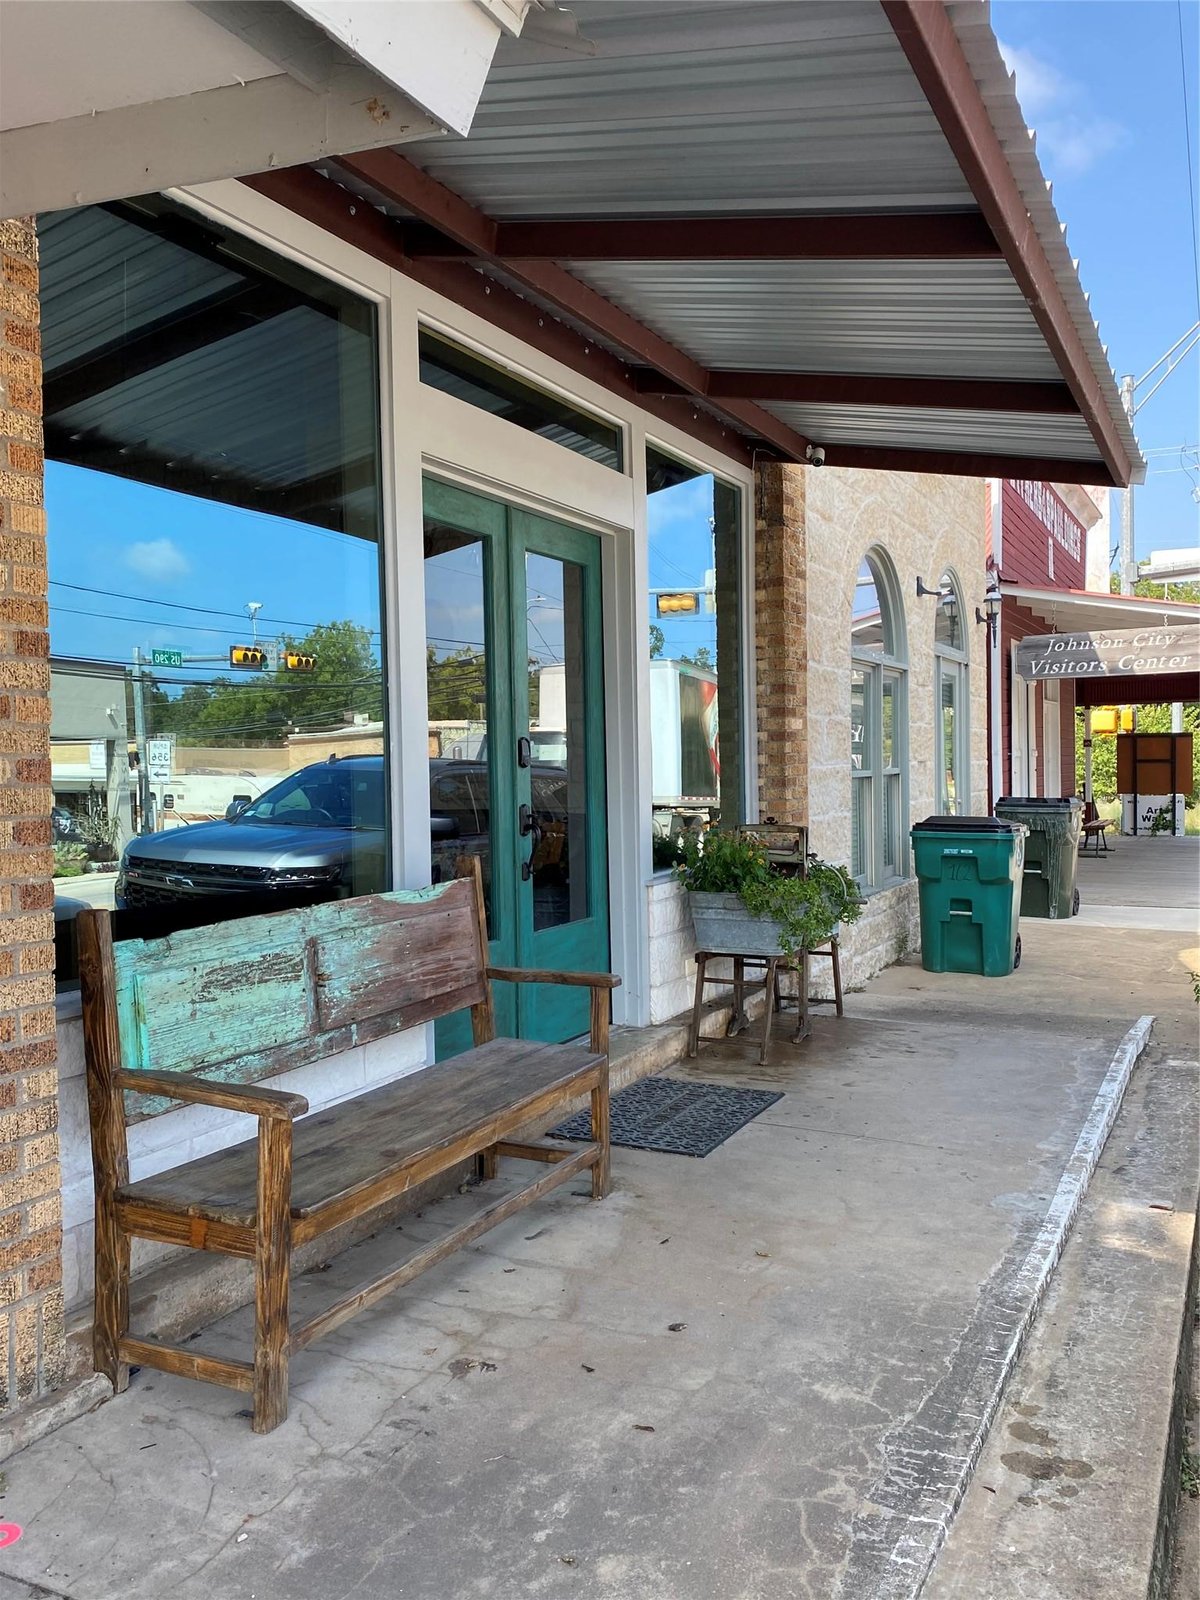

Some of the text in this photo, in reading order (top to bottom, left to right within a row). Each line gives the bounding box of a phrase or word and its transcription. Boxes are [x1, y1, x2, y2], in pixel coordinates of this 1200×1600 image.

[1044, 632, 1176, 656] Johnson City
[1030, 654, 1192, 675] Visitors Center
